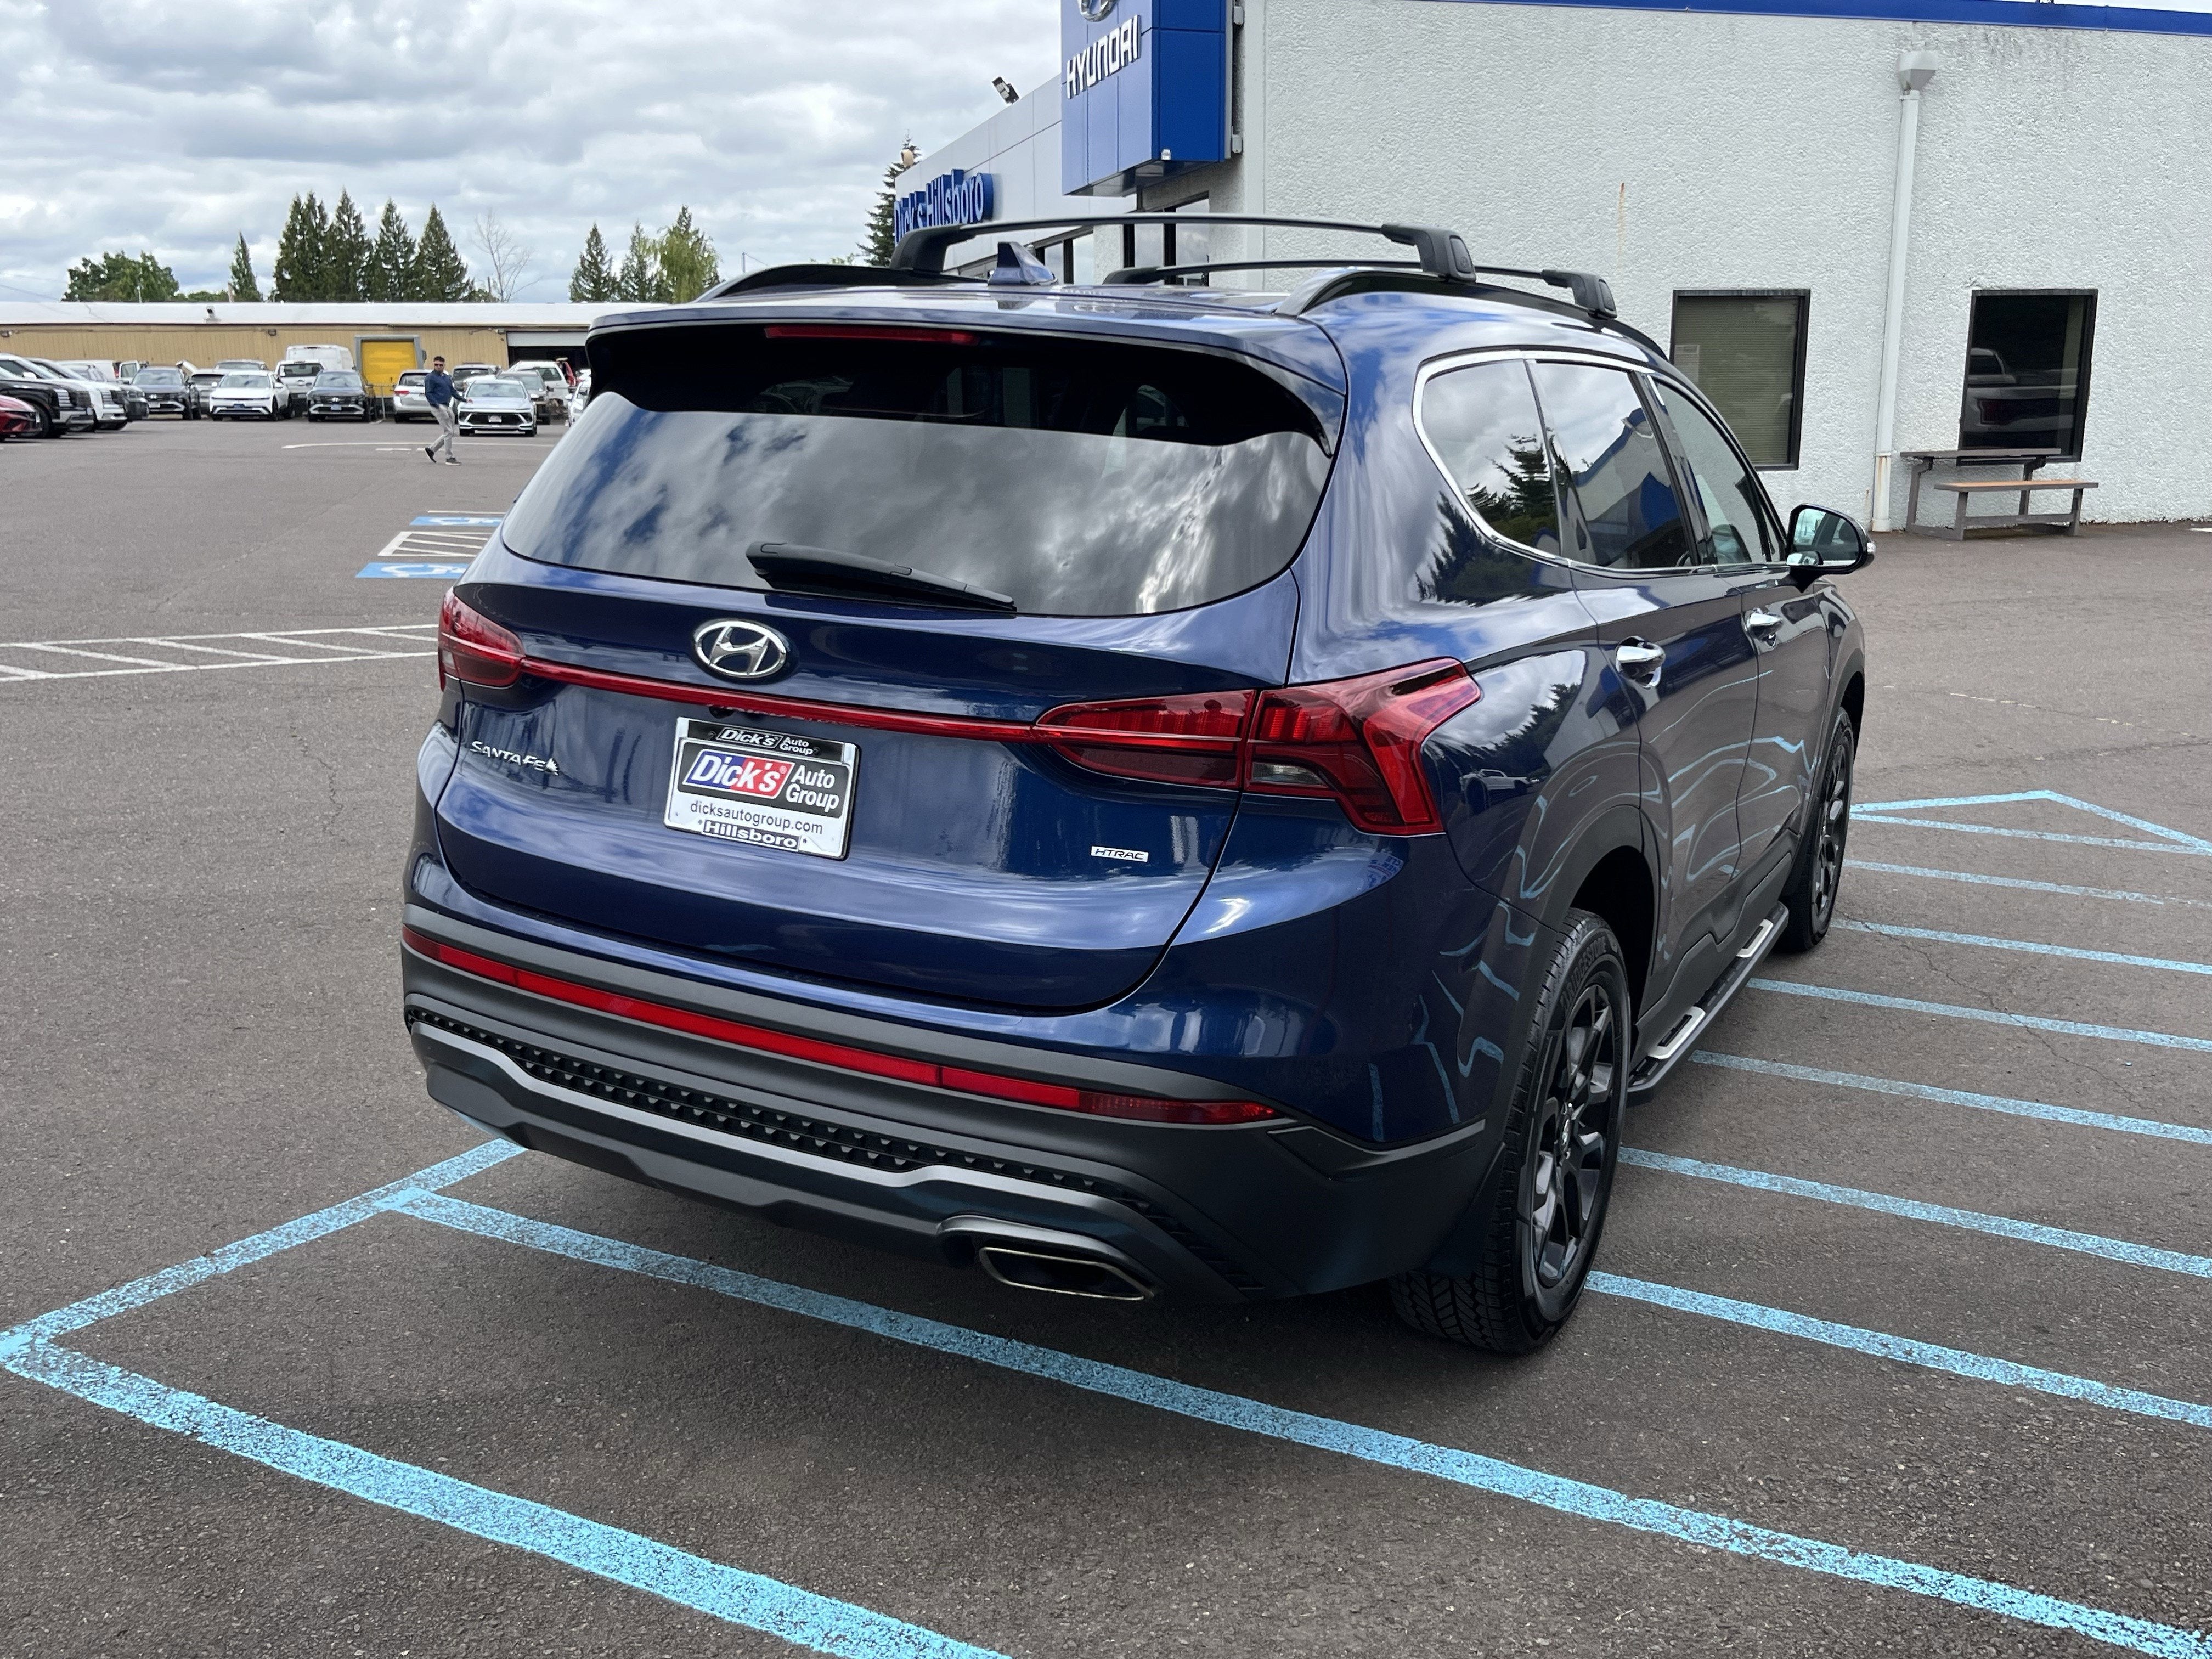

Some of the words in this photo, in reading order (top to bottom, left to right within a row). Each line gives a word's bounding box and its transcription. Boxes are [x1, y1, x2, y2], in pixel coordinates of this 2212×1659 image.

[1066, 15, 1142, 99] HYUNDAI
[894, 191, 925, 248] Dick's
[926, 169, 985, 228] Hillsboro
[720, 729, 777, 746] Dick's
[782, 737, 809, 747] Auto
[779, 743, 814, 755] Group
[470, 741, 521, 765] SANTA
[522, 755, 546, 771] FE
[691, 755, 781, 793] Dick's
[791, 765, 835, 789] Auto
[786, 783, 840, 812] Group
[690, 800, 823, 834] dicksautogroup.com
[703, 821, 797, 849] Hillsboro
[1095, 848, 1144, 860] HTRAC
